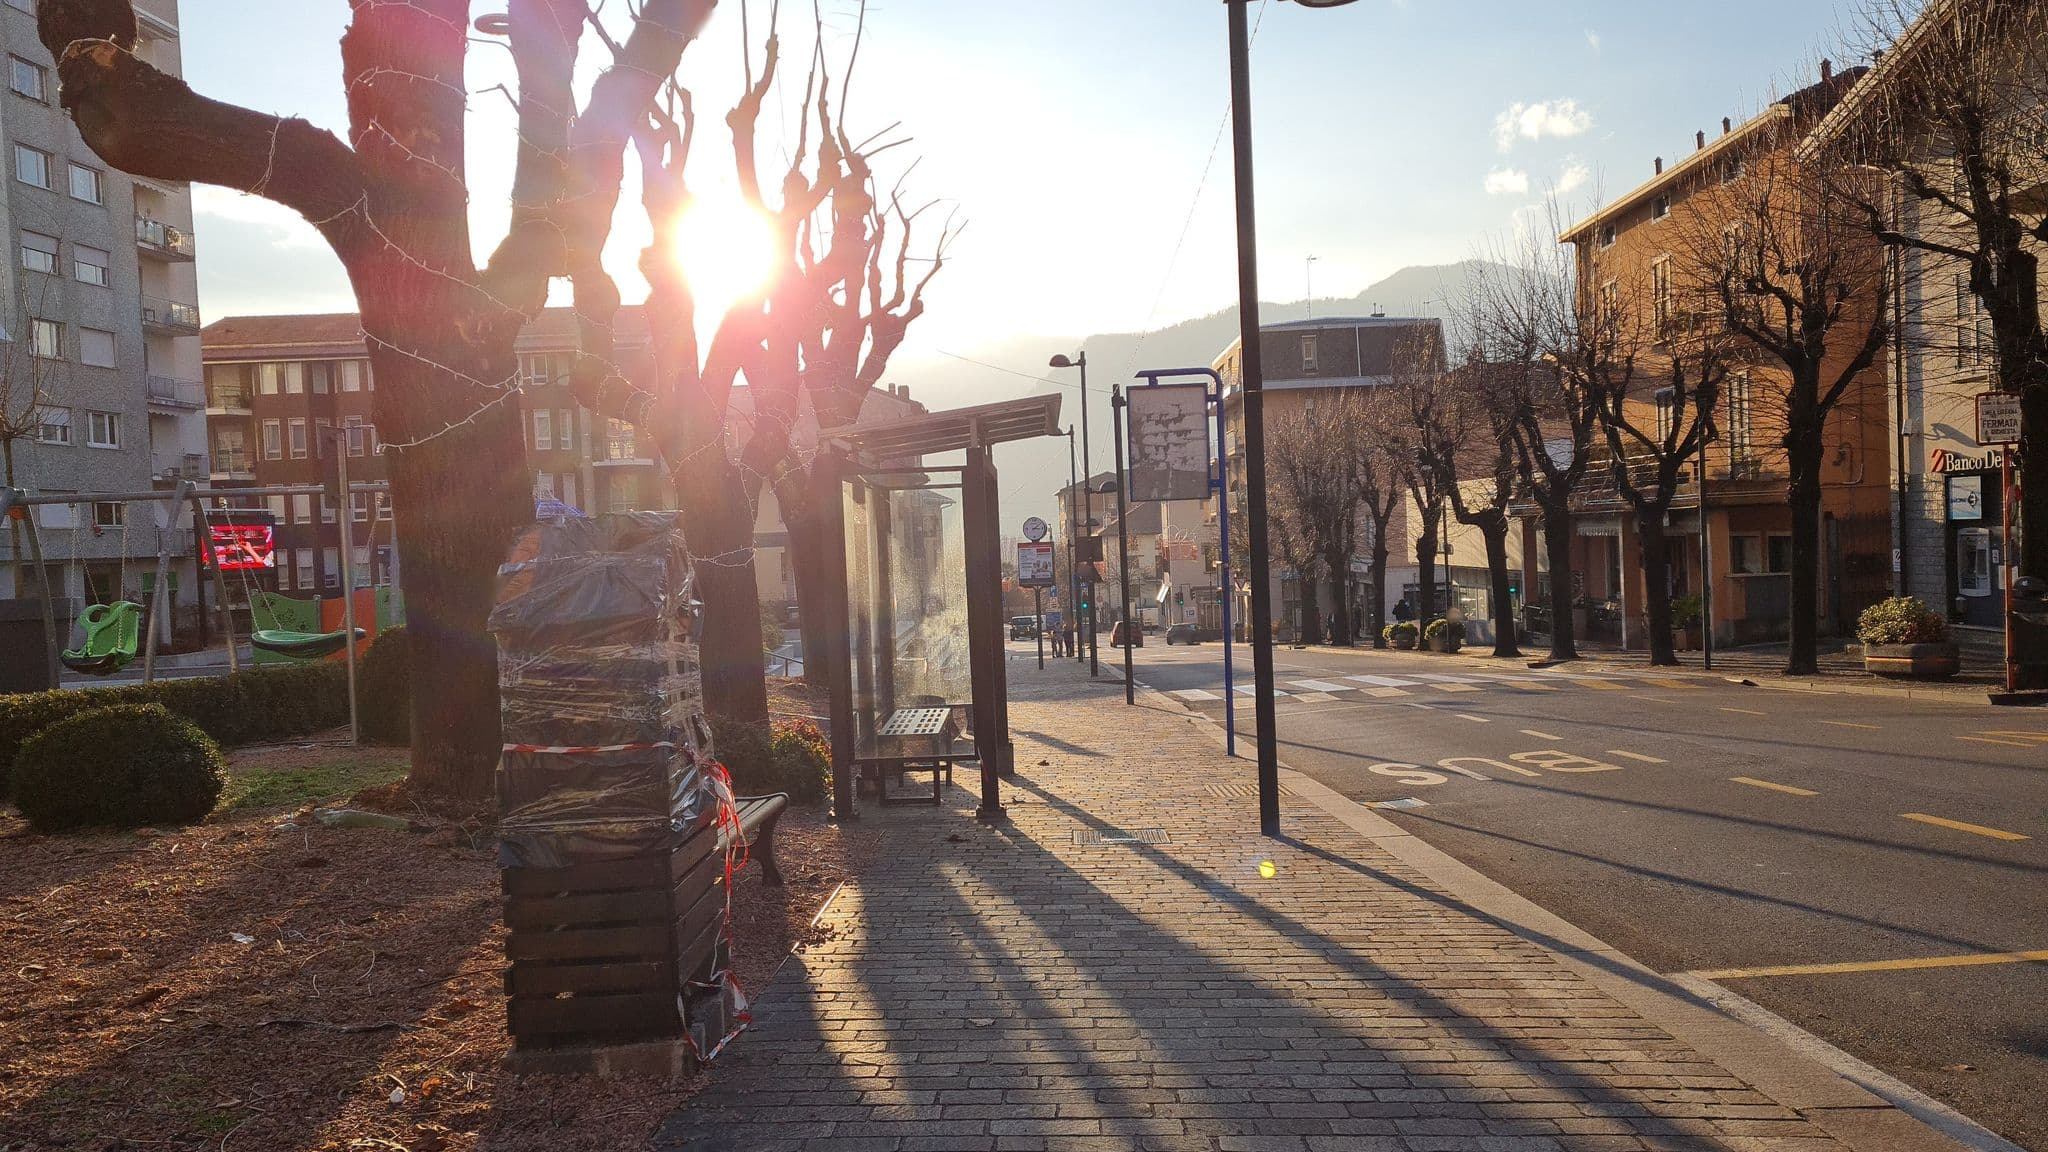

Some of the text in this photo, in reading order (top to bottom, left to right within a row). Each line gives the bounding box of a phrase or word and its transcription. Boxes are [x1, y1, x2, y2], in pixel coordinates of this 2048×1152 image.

[1982, 418, 2018, 428] FERMATA
[1945, 453, 1982, 472] Banco
[1368, 750, 1625, 786] BUS
